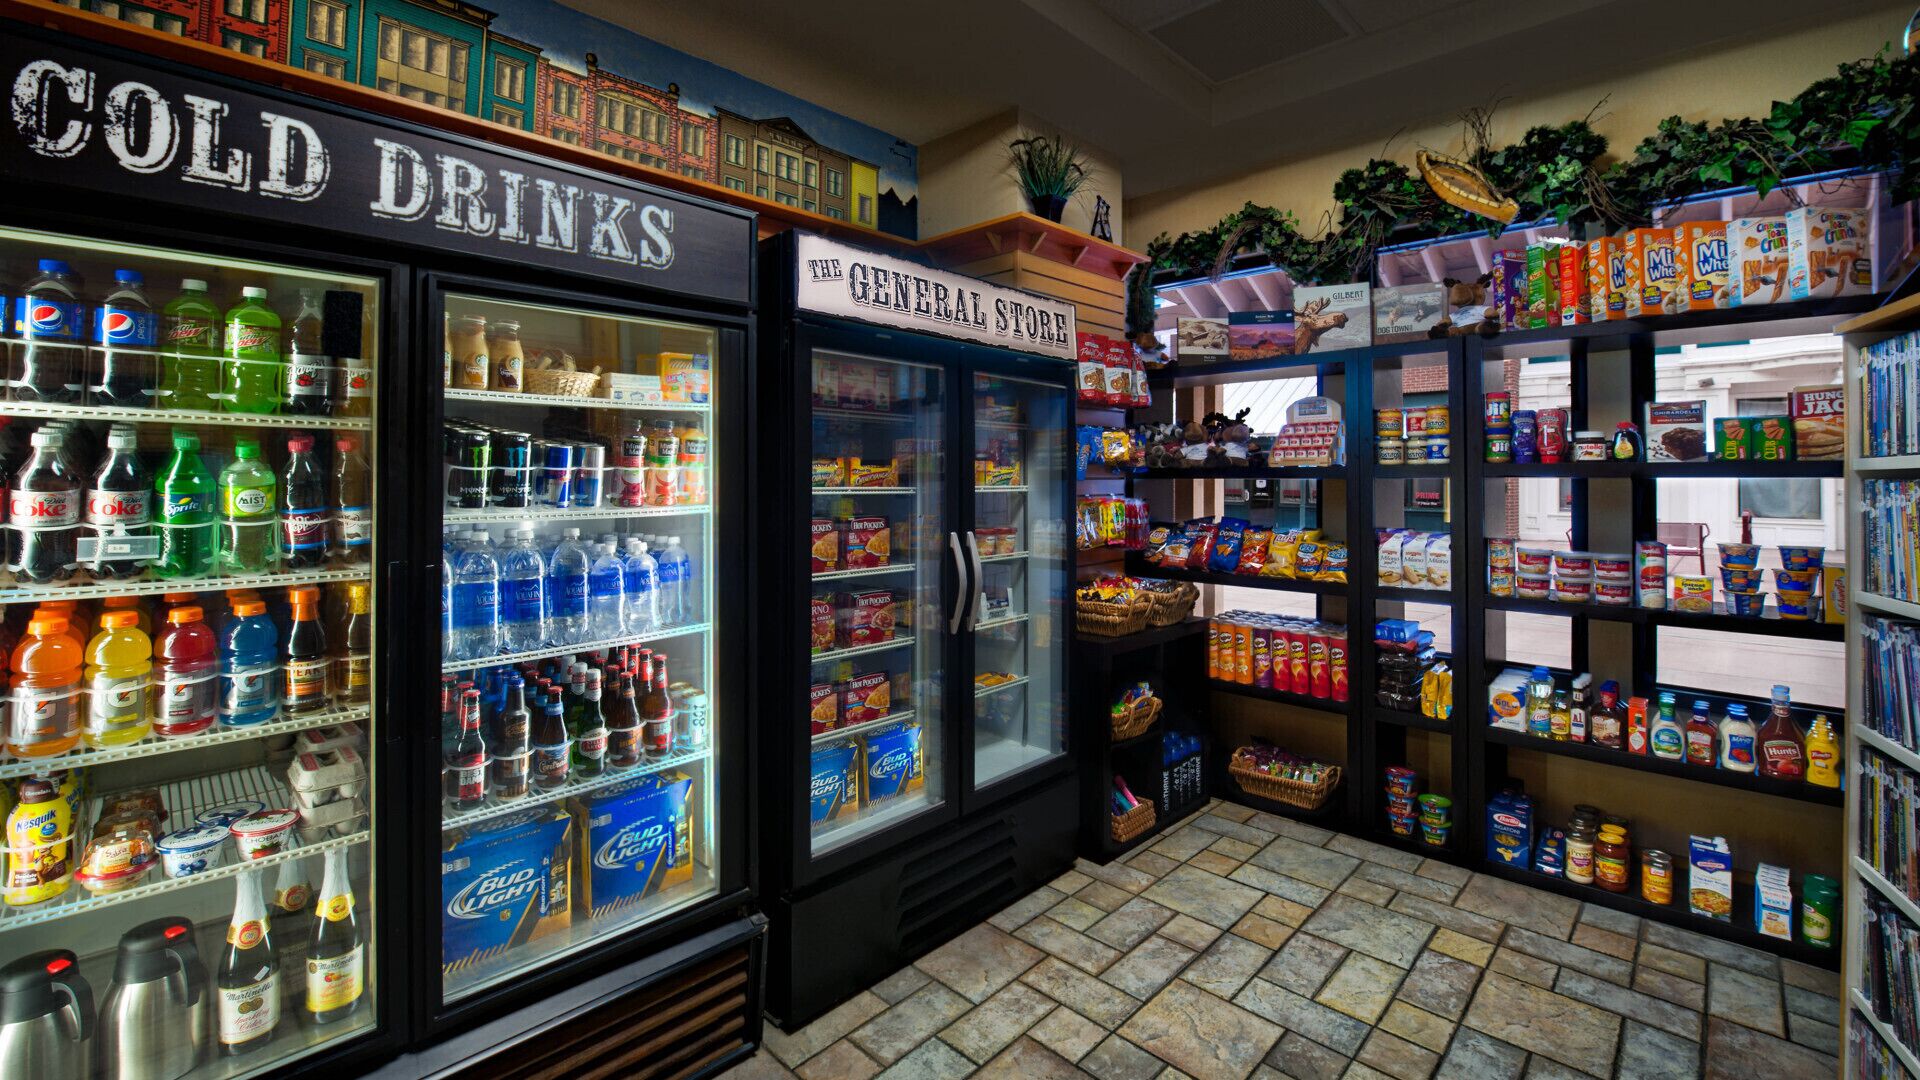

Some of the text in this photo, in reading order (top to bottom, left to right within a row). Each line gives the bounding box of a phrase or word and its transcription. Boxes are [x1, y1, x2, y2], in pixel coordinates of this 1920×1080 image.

[11, 59, 675, 270] COLD DRINKS
[808, 258, 1069, 348] THE GENERAL STORE
[1333, 290, 1363, 300] GILBERT
[137, 316, 146, 340] pepsi
[1804, 393, 1844, 401] HUNG
[1486, 402, 1509, 416] Jif
[1802, 401, 1844, 416] JAC
[1492, 443, 1510, 452] Jif
[1725, 440, 1738, 460] CLUB
[1764, 440, 1777, 460] CLUB
[11, 499, 67, 517] Coke
[88, 499, 143, 516] Coke
[166, 501, 202, 515] Sprite
[239, 495, 266, 506] MIST
[812, 522, 832, 532] OCKETS
[1219, 530, 1242, 538] Doritos
[812, 686, 832, 698] OCKETS
[883, 752, 907, 767] BUD
[1769, 747, 1798, 756] Hunt's
[878, 758, 910, 775] LIGHT
[812, 774, 839, 788] BUD
[812, 780, 842, 797] IGHT
[16, 810, 57, 832] Nesquik
[1493, 823, 1521, 834] RIGATONI
[618, 823, 665, 849] BUD
[105, 846, 129, 859] Sabra
[608, 829, 670, 863] LIGHT
[477, 868, 535, 895] BUD
[466, 876, 544, 913] LIGHT
[226, 981, 274, 1001] Martinelli's
